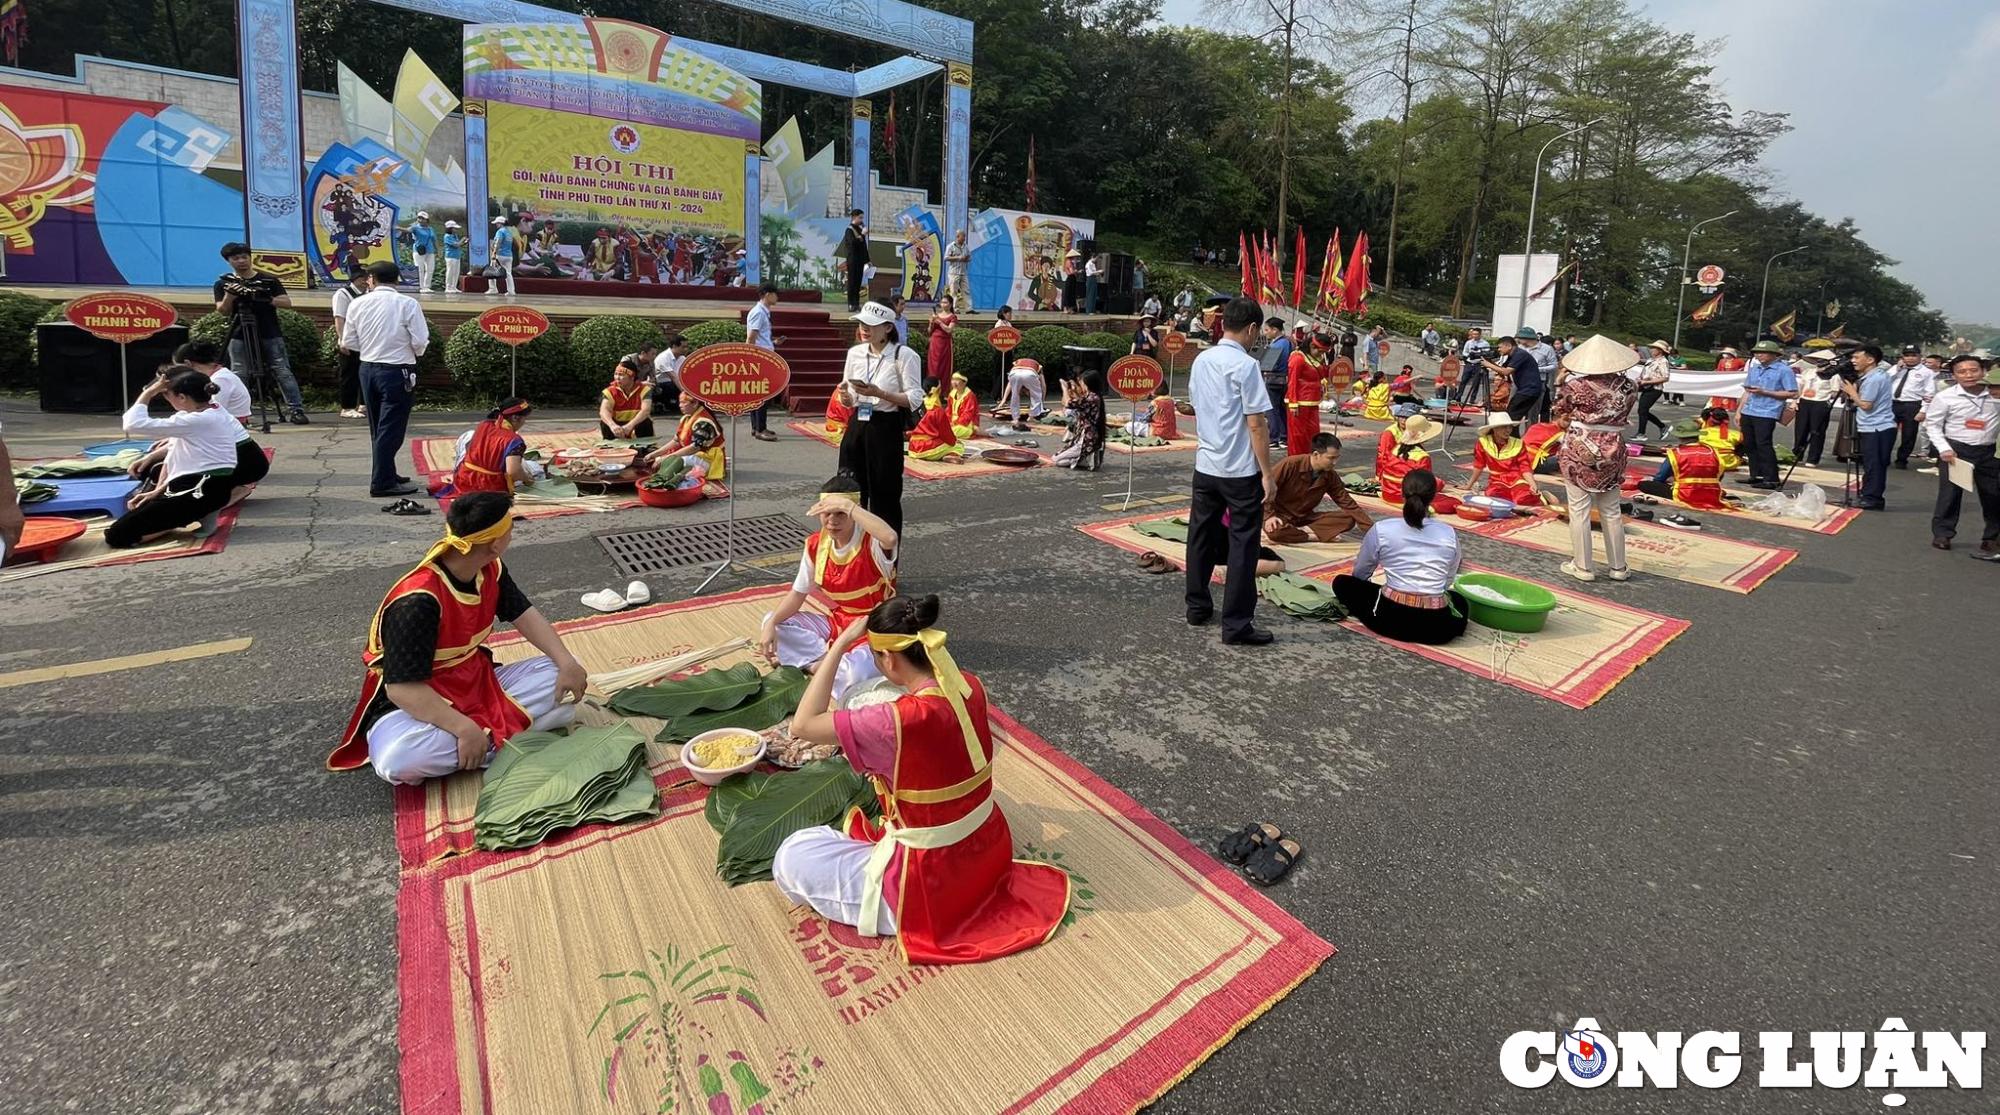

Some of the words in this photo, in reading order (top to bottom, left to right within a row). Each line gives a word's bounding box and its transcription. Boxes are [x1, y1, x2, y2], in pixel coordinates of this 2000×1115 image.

[573, 155, 621, 177] HỘI
[629, 162, 674, 181] THI
[600, 179, 635, 191] CHƯNG
[661, 200, 671, 211] XI
[680, 203, 703, 214] 2024
[97, 303, 147, 315] ĐOÀN
[83, 316, 130, 327] THANH
[133, 317, 161, 328] SƠN
[499, 314, 530, 324] ĐOÀN
[489, 324, 503, 333] TX.
[504, 323, 522, 333] PHÚ
[523, 325, 539, 335] THỌ
[712, 359, 761, 376] ĐOÀN
[1124, 366, 1149, 377] ĐOÀN
[700, 376, 736, 395] CẨM
[741, 378, 770, 395] KHÊ
[1118, 377, 1135, 389] TÂN
[1136, 378, 1154, 389] SƠN
